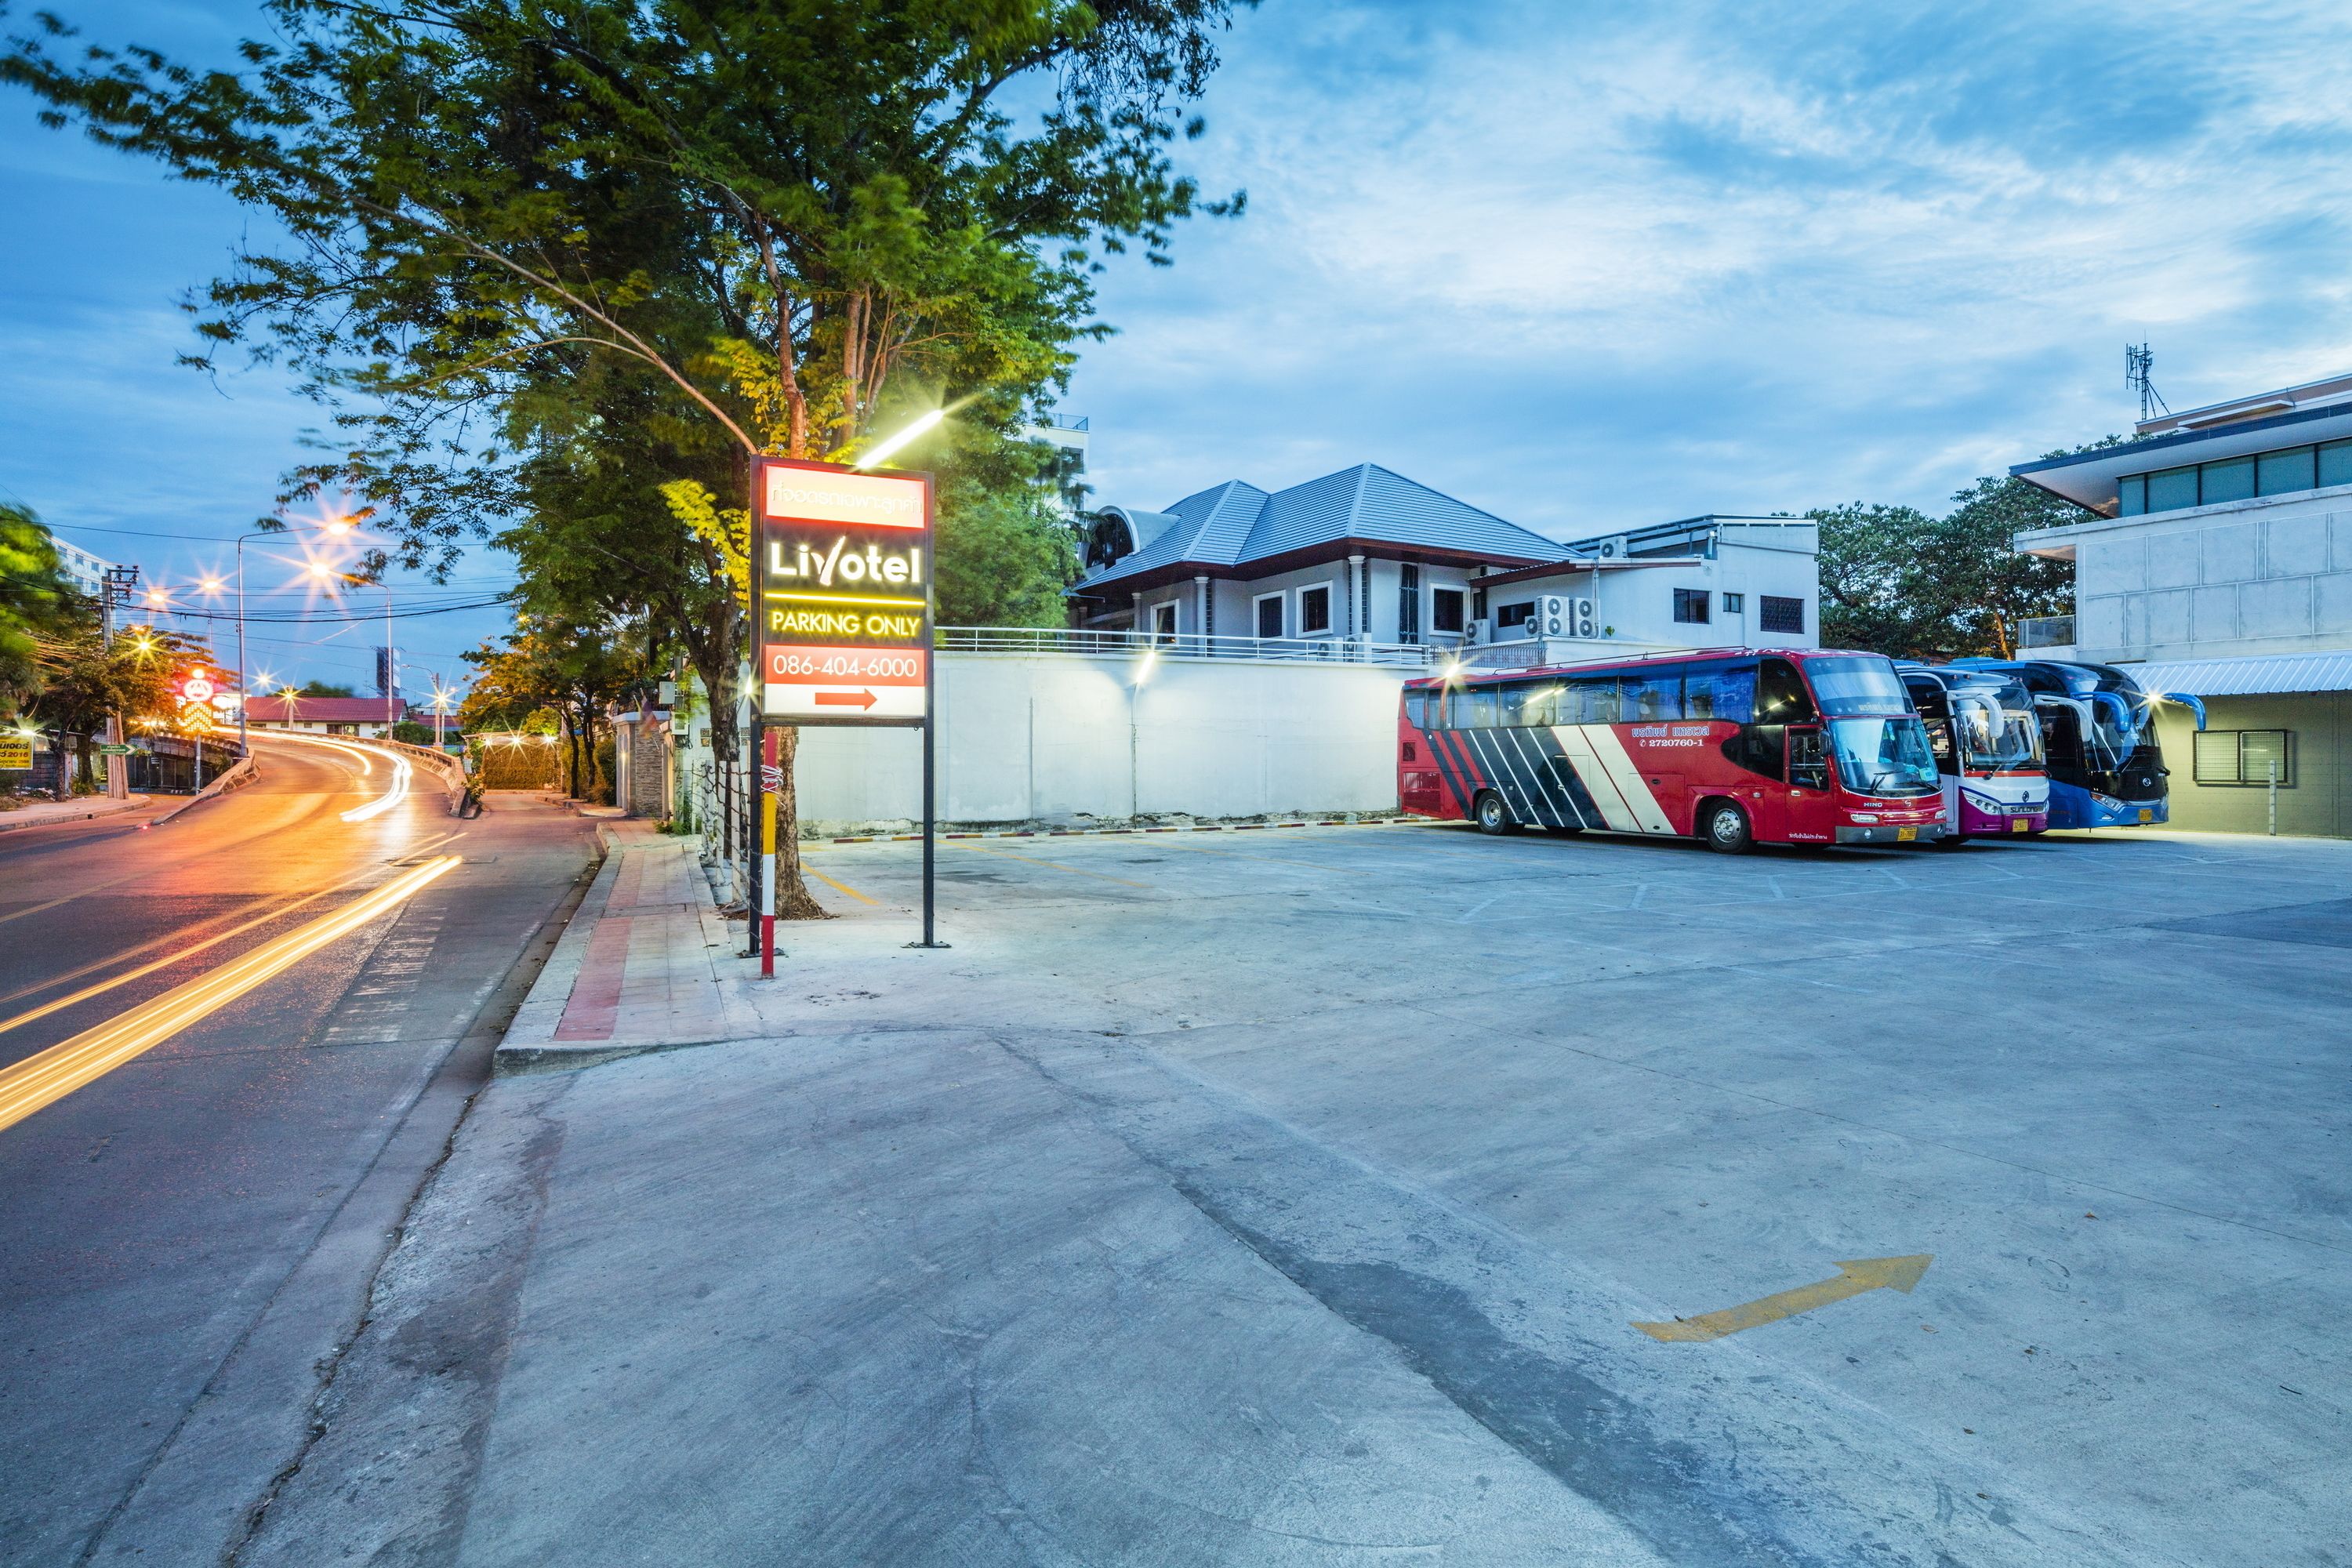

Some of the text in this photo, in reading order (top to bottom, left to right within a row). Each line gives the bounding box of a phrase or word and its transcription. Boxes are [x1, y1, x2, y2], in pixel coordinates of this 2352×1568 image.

[771, 535, 920, 586] Livotel
[772, 612, 920, 637] PARKING ONLY
[773, 654, 917, 677] 086-404-6000
